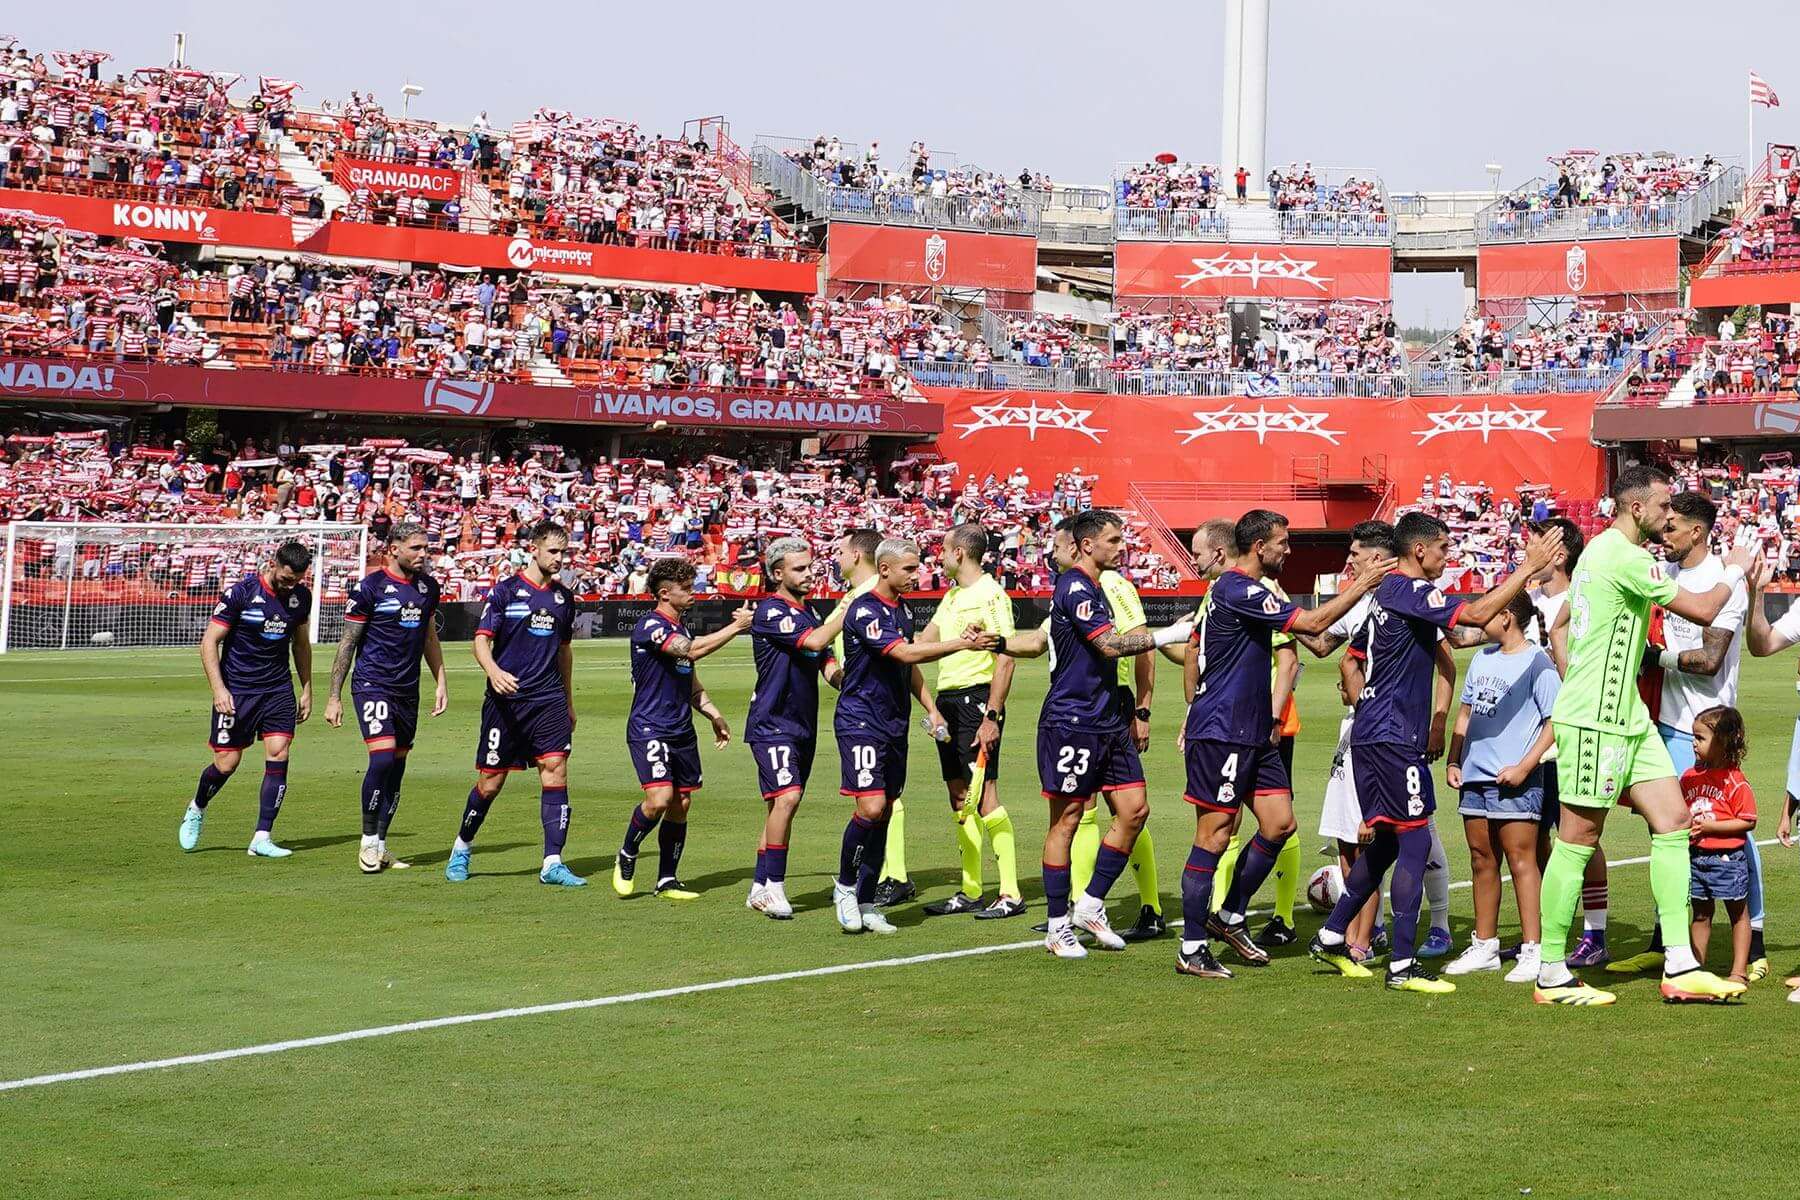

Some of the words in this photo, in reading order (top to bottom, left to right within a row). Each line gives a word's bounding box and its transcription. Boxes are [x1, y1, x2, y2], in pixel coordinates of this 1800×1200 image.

[113, 203, 207, 232] KONNY
[533, 246, 592, 261] micamotor
[594, 393, 722, 420] ¡VAMOS,
[729, 399, 882, 425] GRANADA!
[363, 701, 388, 722] 20
[487, 728, 501, 750] 9
[646, 740, 669, 763] 21
[768, 746, 790, 770] 17
[851, 745, 876, 770] 10
[1057, 746, 1091, 776] 23
[1221, 753, 1239, 782] 4
[1406, 765, 1420, 795] 8
